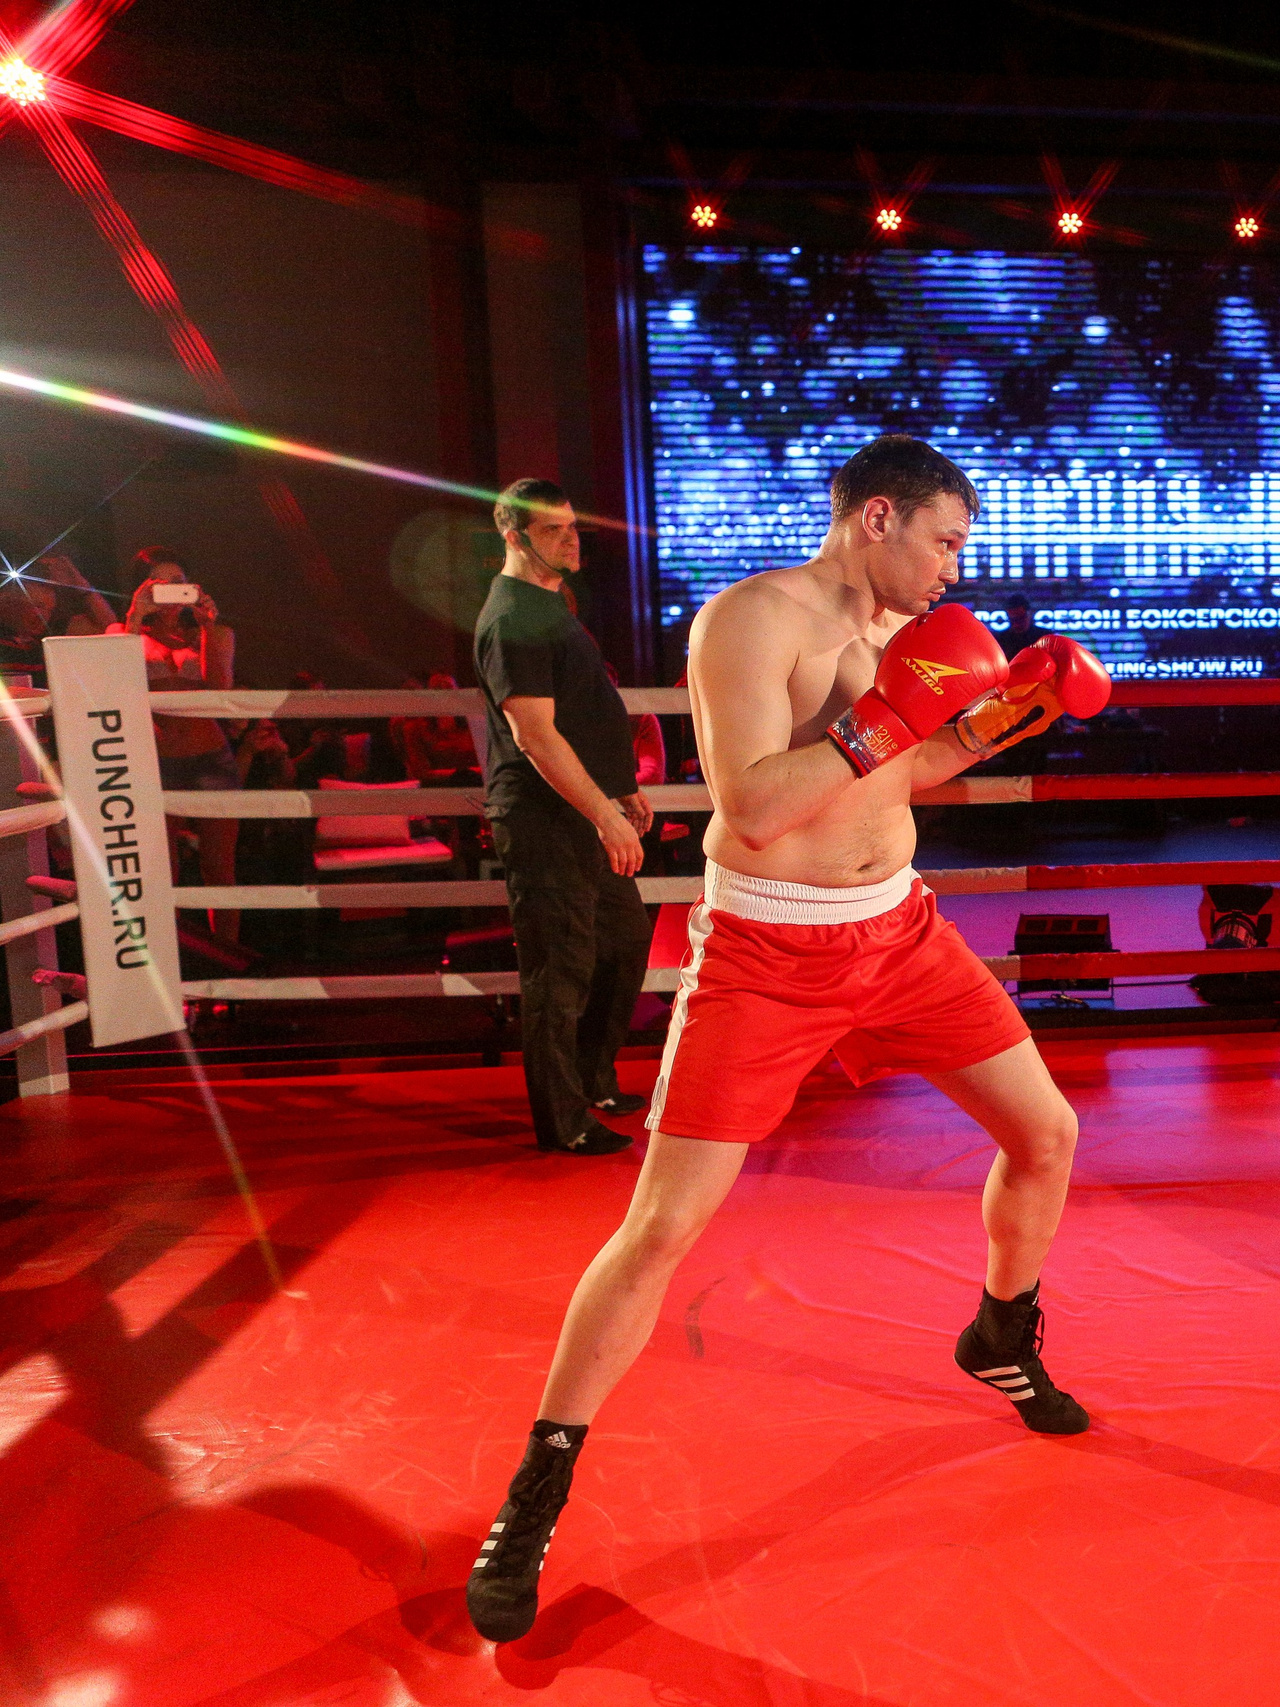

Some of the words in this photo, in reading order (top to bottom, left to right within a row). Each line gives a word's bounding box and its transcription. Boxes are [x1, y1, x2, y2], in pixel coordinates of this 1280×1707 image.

[1034, 609, 1121, 631] СЕЗОН
[901, 657, 944, 695] AMIGO
[87, 709, 149, 970] PUNCHER.RU
